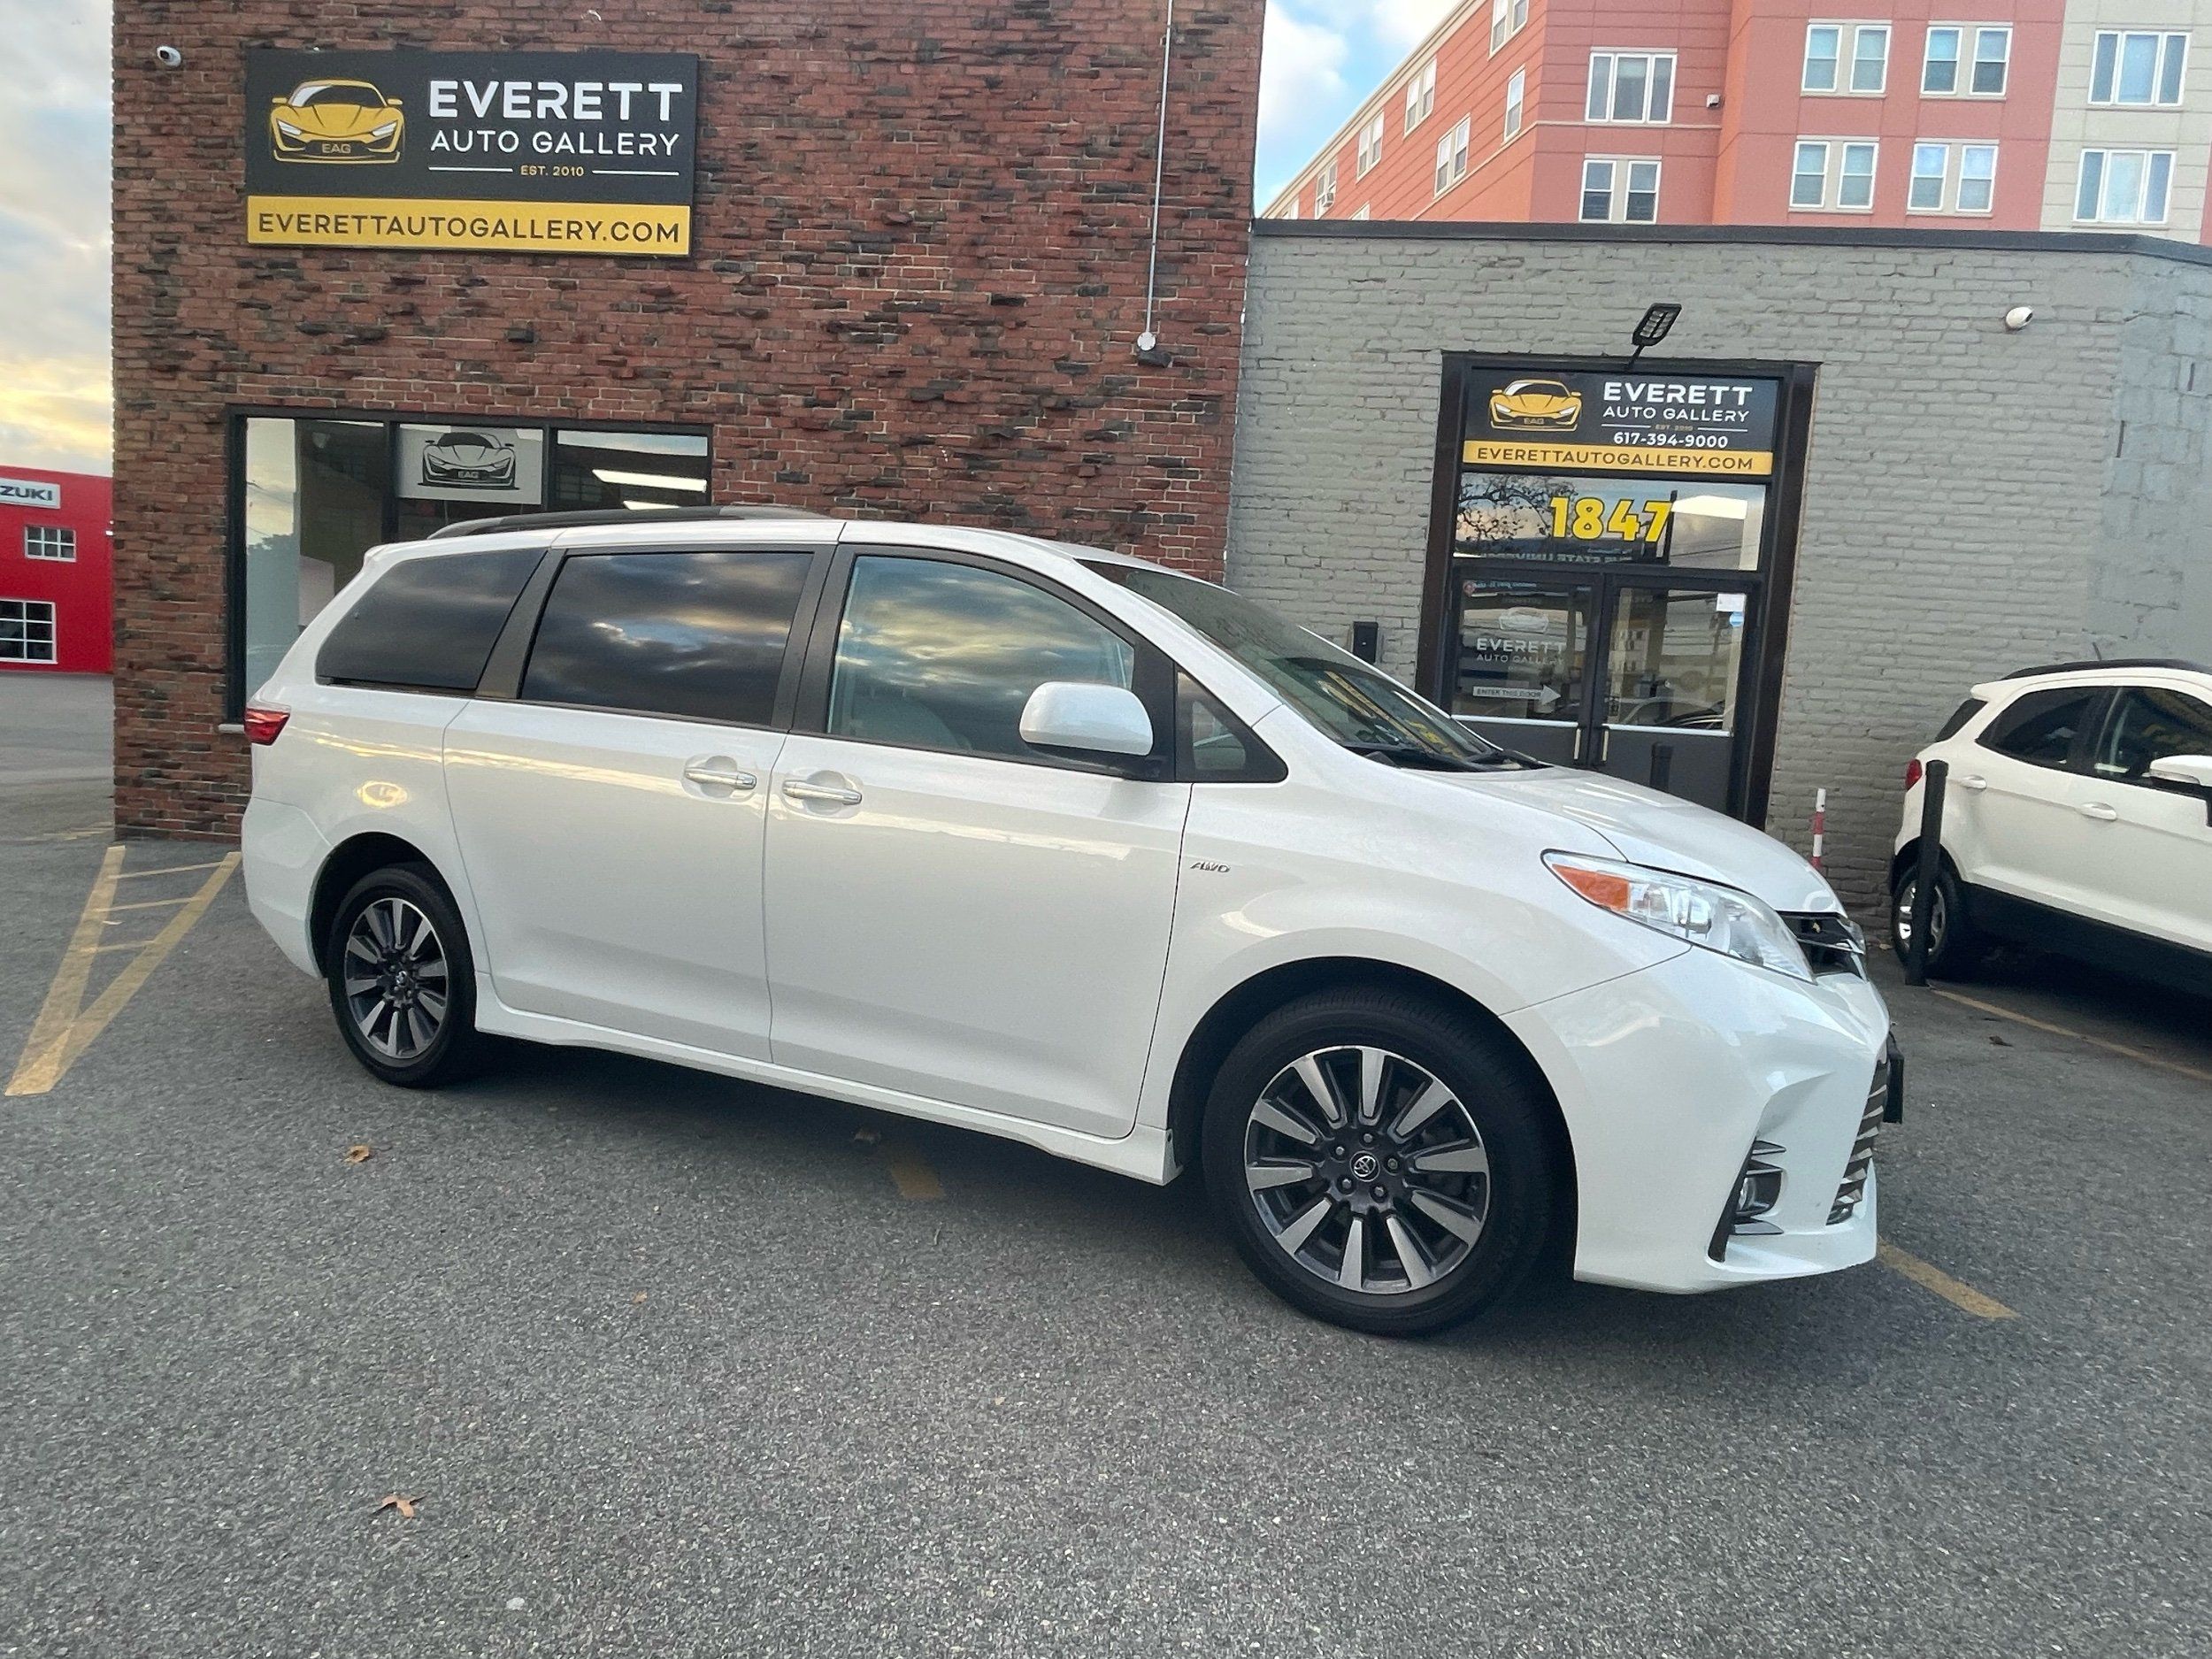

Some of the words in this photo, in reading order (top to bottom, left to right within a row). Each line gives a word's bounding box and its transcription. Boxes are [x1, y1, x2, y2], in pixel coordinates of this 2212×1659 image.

[429, 80, 682, 121] EVERETT
[321, 143, 351, 154] EAG
[430, 130, 519, 153] AUTO
[532, 132, 680, 156] GALLERY
[520, 165, 549, 176] EST.
[553, 165, 584, 177] 2010
[258, 211, 680, 243] EVERETTAUTOGALLERY.COM
[1603, 381, 1753, 405] EVERETT
[1603, 406, 1656, 419] AUTO
[1663, 408, 1749, 422] GALLERY
[1613, 432, 1728, 448] 617-394-9000
[1478, 447, 1753, 470] EVERETTAUTOGALLERY.COM
[1549, 496, 1673, 542] 1847
[1476, 638, 1567, 654] EVERETT
[1476, 654, 1509, 663] AUTO
[1189, 862, 1231, 873] AWD
